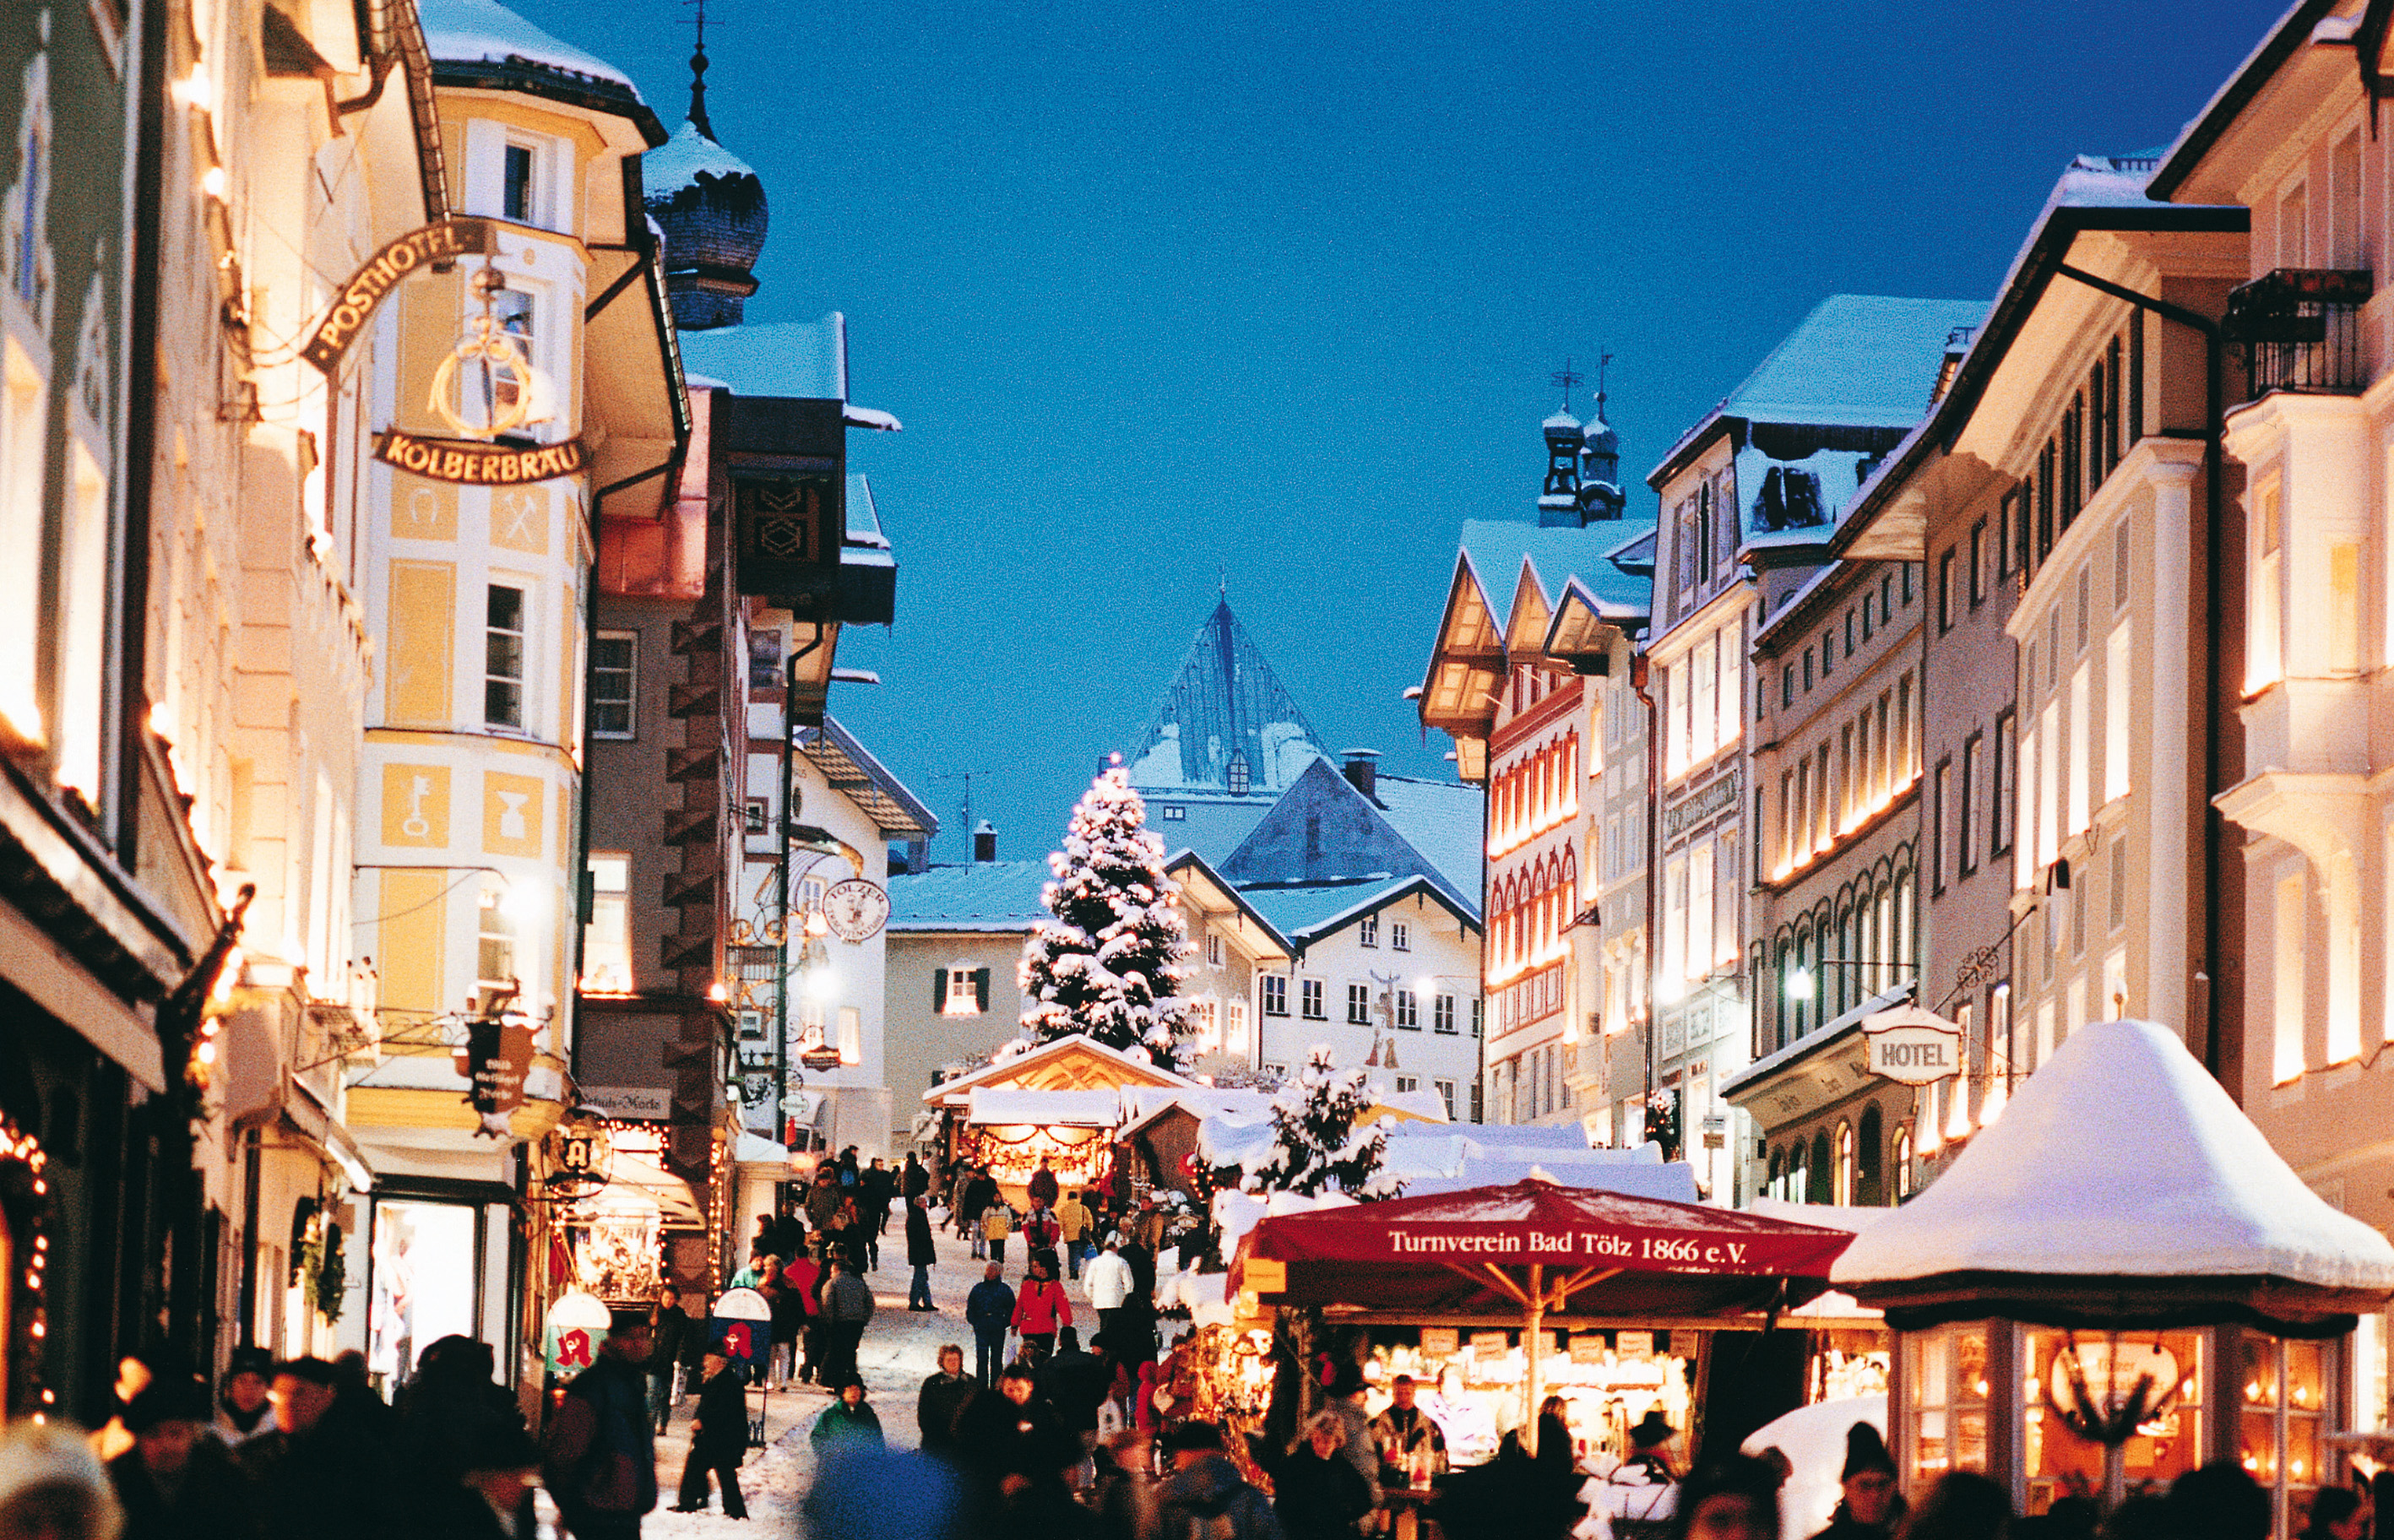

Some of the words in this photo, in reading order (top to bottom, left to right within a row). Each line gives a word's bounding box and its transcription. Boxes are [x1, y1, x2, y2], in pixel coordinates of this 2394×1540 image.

[318, 225, 464, 349] POSTHOTEL
[1881, 1043, 1950, 1067] HOTEL
[1387, 1230, 1521, 1252] Turnverein
[1528, 1231, 1572, 1253] Bad
[1580, 1233, 1633, 1257] Tölz
[1642, 1239, 1700, 1261] 1866
